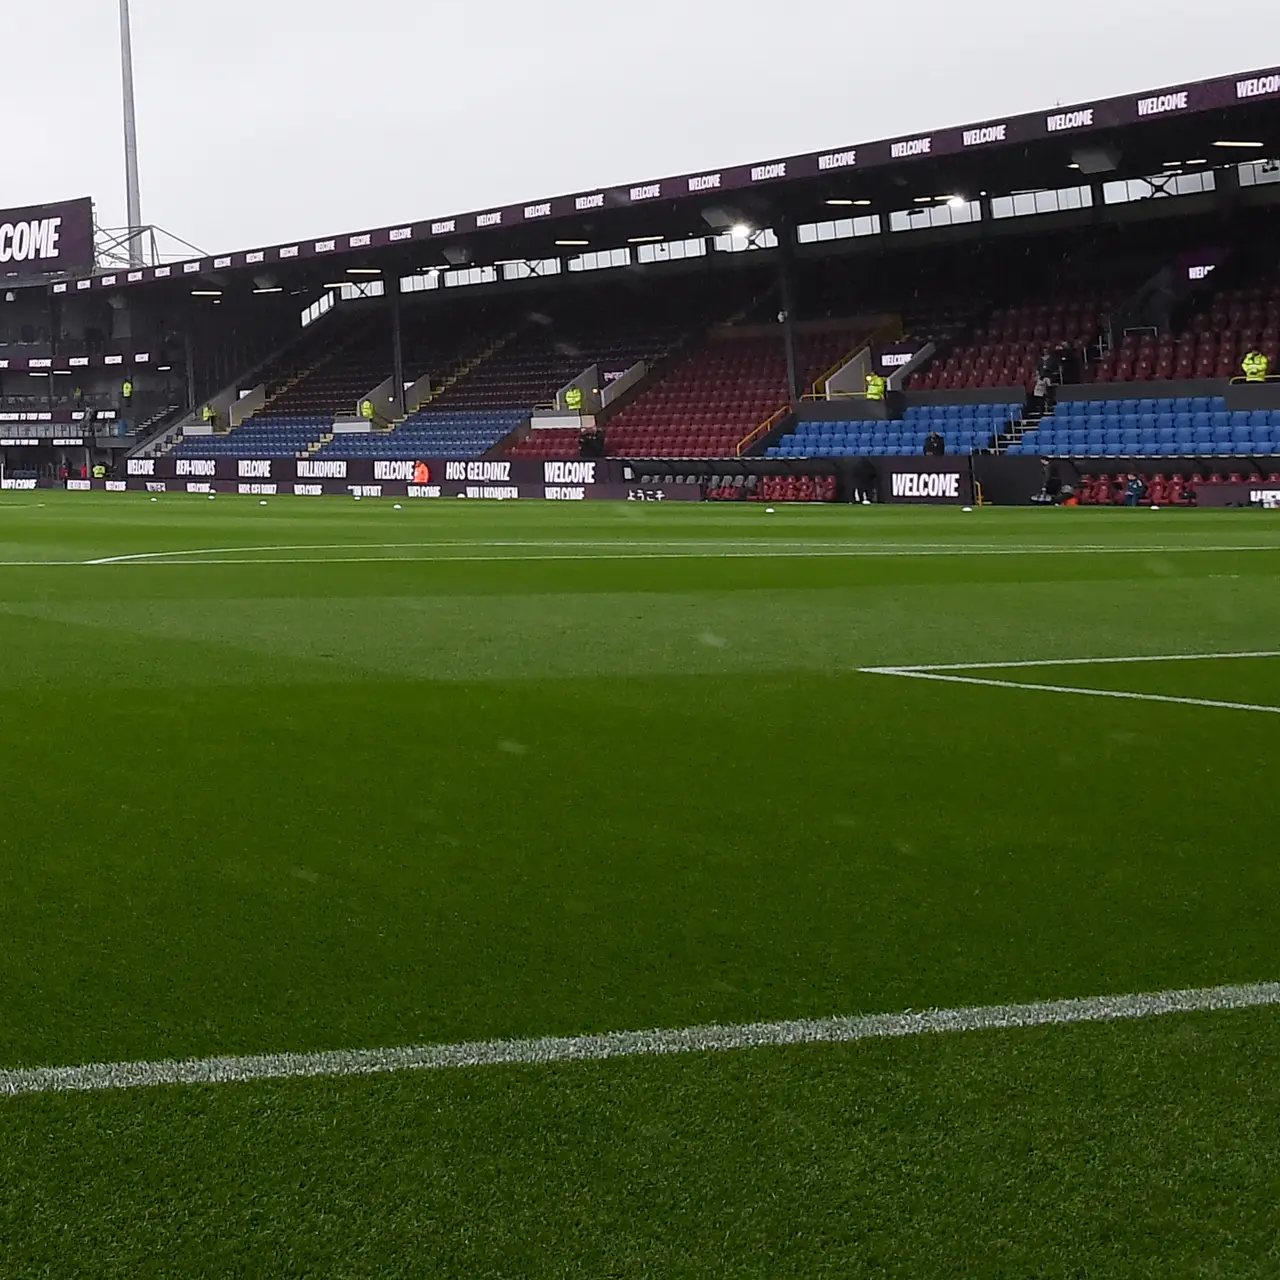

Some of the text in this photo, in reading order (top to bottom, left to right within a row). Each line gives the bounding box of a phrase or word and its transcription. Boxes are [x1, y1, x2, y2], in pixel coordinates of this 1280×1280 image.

[1138, 92, 1187, 115] WELCOME
[1048, 109, 1093, 131] WELCOME
[963, 125, 1006, 145] WELCOME
[891, 138, 931, 157] WELCOME
[819, 151, 855, 169] WELCOME
[752, 163, 785, 180] WELCOME
[689, 174, 720, 190] WELCOME
[630, 184, 660, 200] WELCOME
[576, 194, 603, 209] WELCOME
[128, 460, 154, 474] WELCOME
[239, 461, 271, 477] WELCOME
[297, 461, 346, 477] WILLKOMMEN
[375, 461, 414, 479] WELCOME
[446, 462, 510, 480] HOS GELDINIZ
[545, 462, 595, 483] WELCOME
[893, 474, 959, 496] WELCOME
